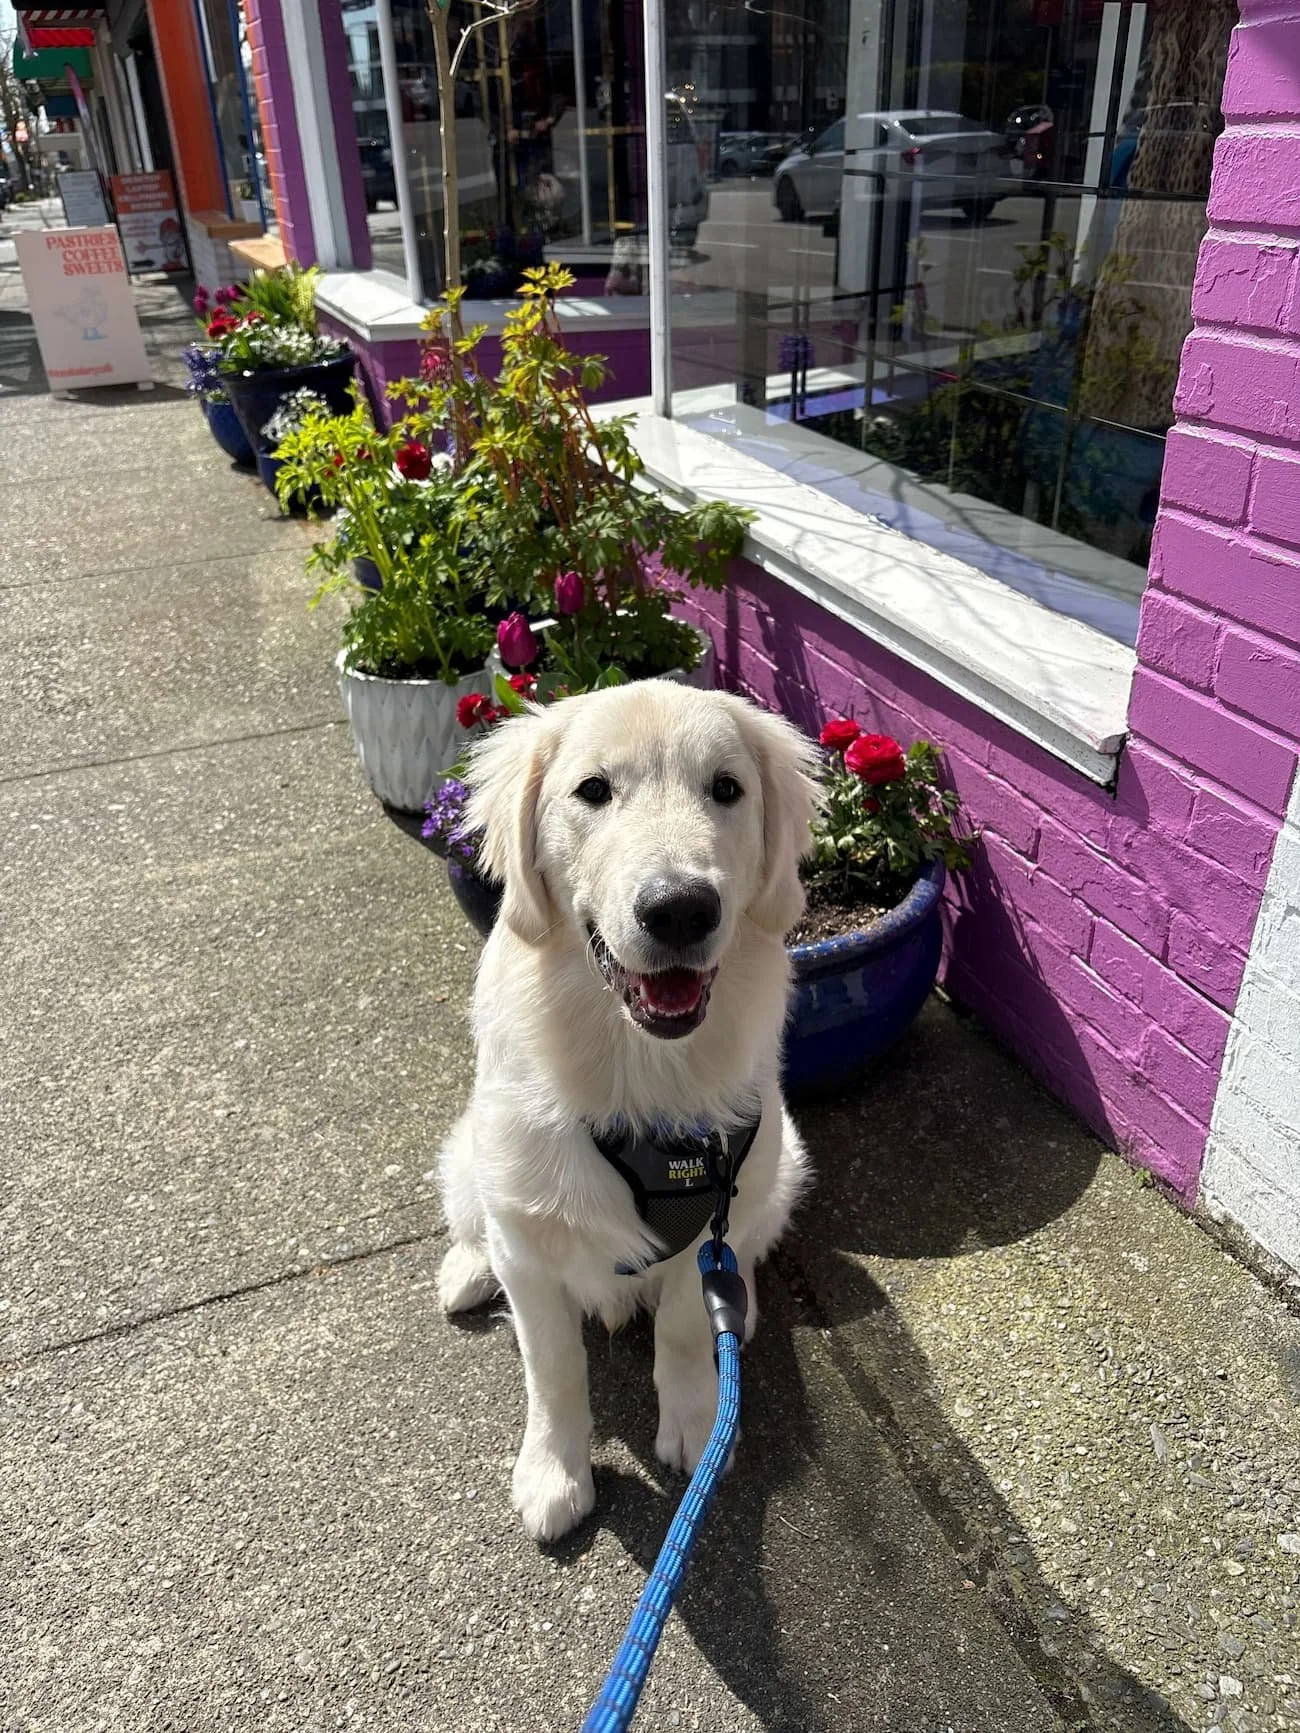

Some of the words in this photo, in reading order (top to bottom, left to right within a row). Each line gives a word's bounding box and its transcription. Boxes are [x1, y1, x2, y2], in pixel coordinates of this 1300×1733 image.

[46, 232, 118, 250] PASTRIES
[63, 246, 118, 261] COFFEE
[63, 260, 123, 276] SWEETS
[668, 1157, 704, 1170] WALK
[668, 1166, 704, 1179] RIGHT
[685, 1178, 694, 1187] L
